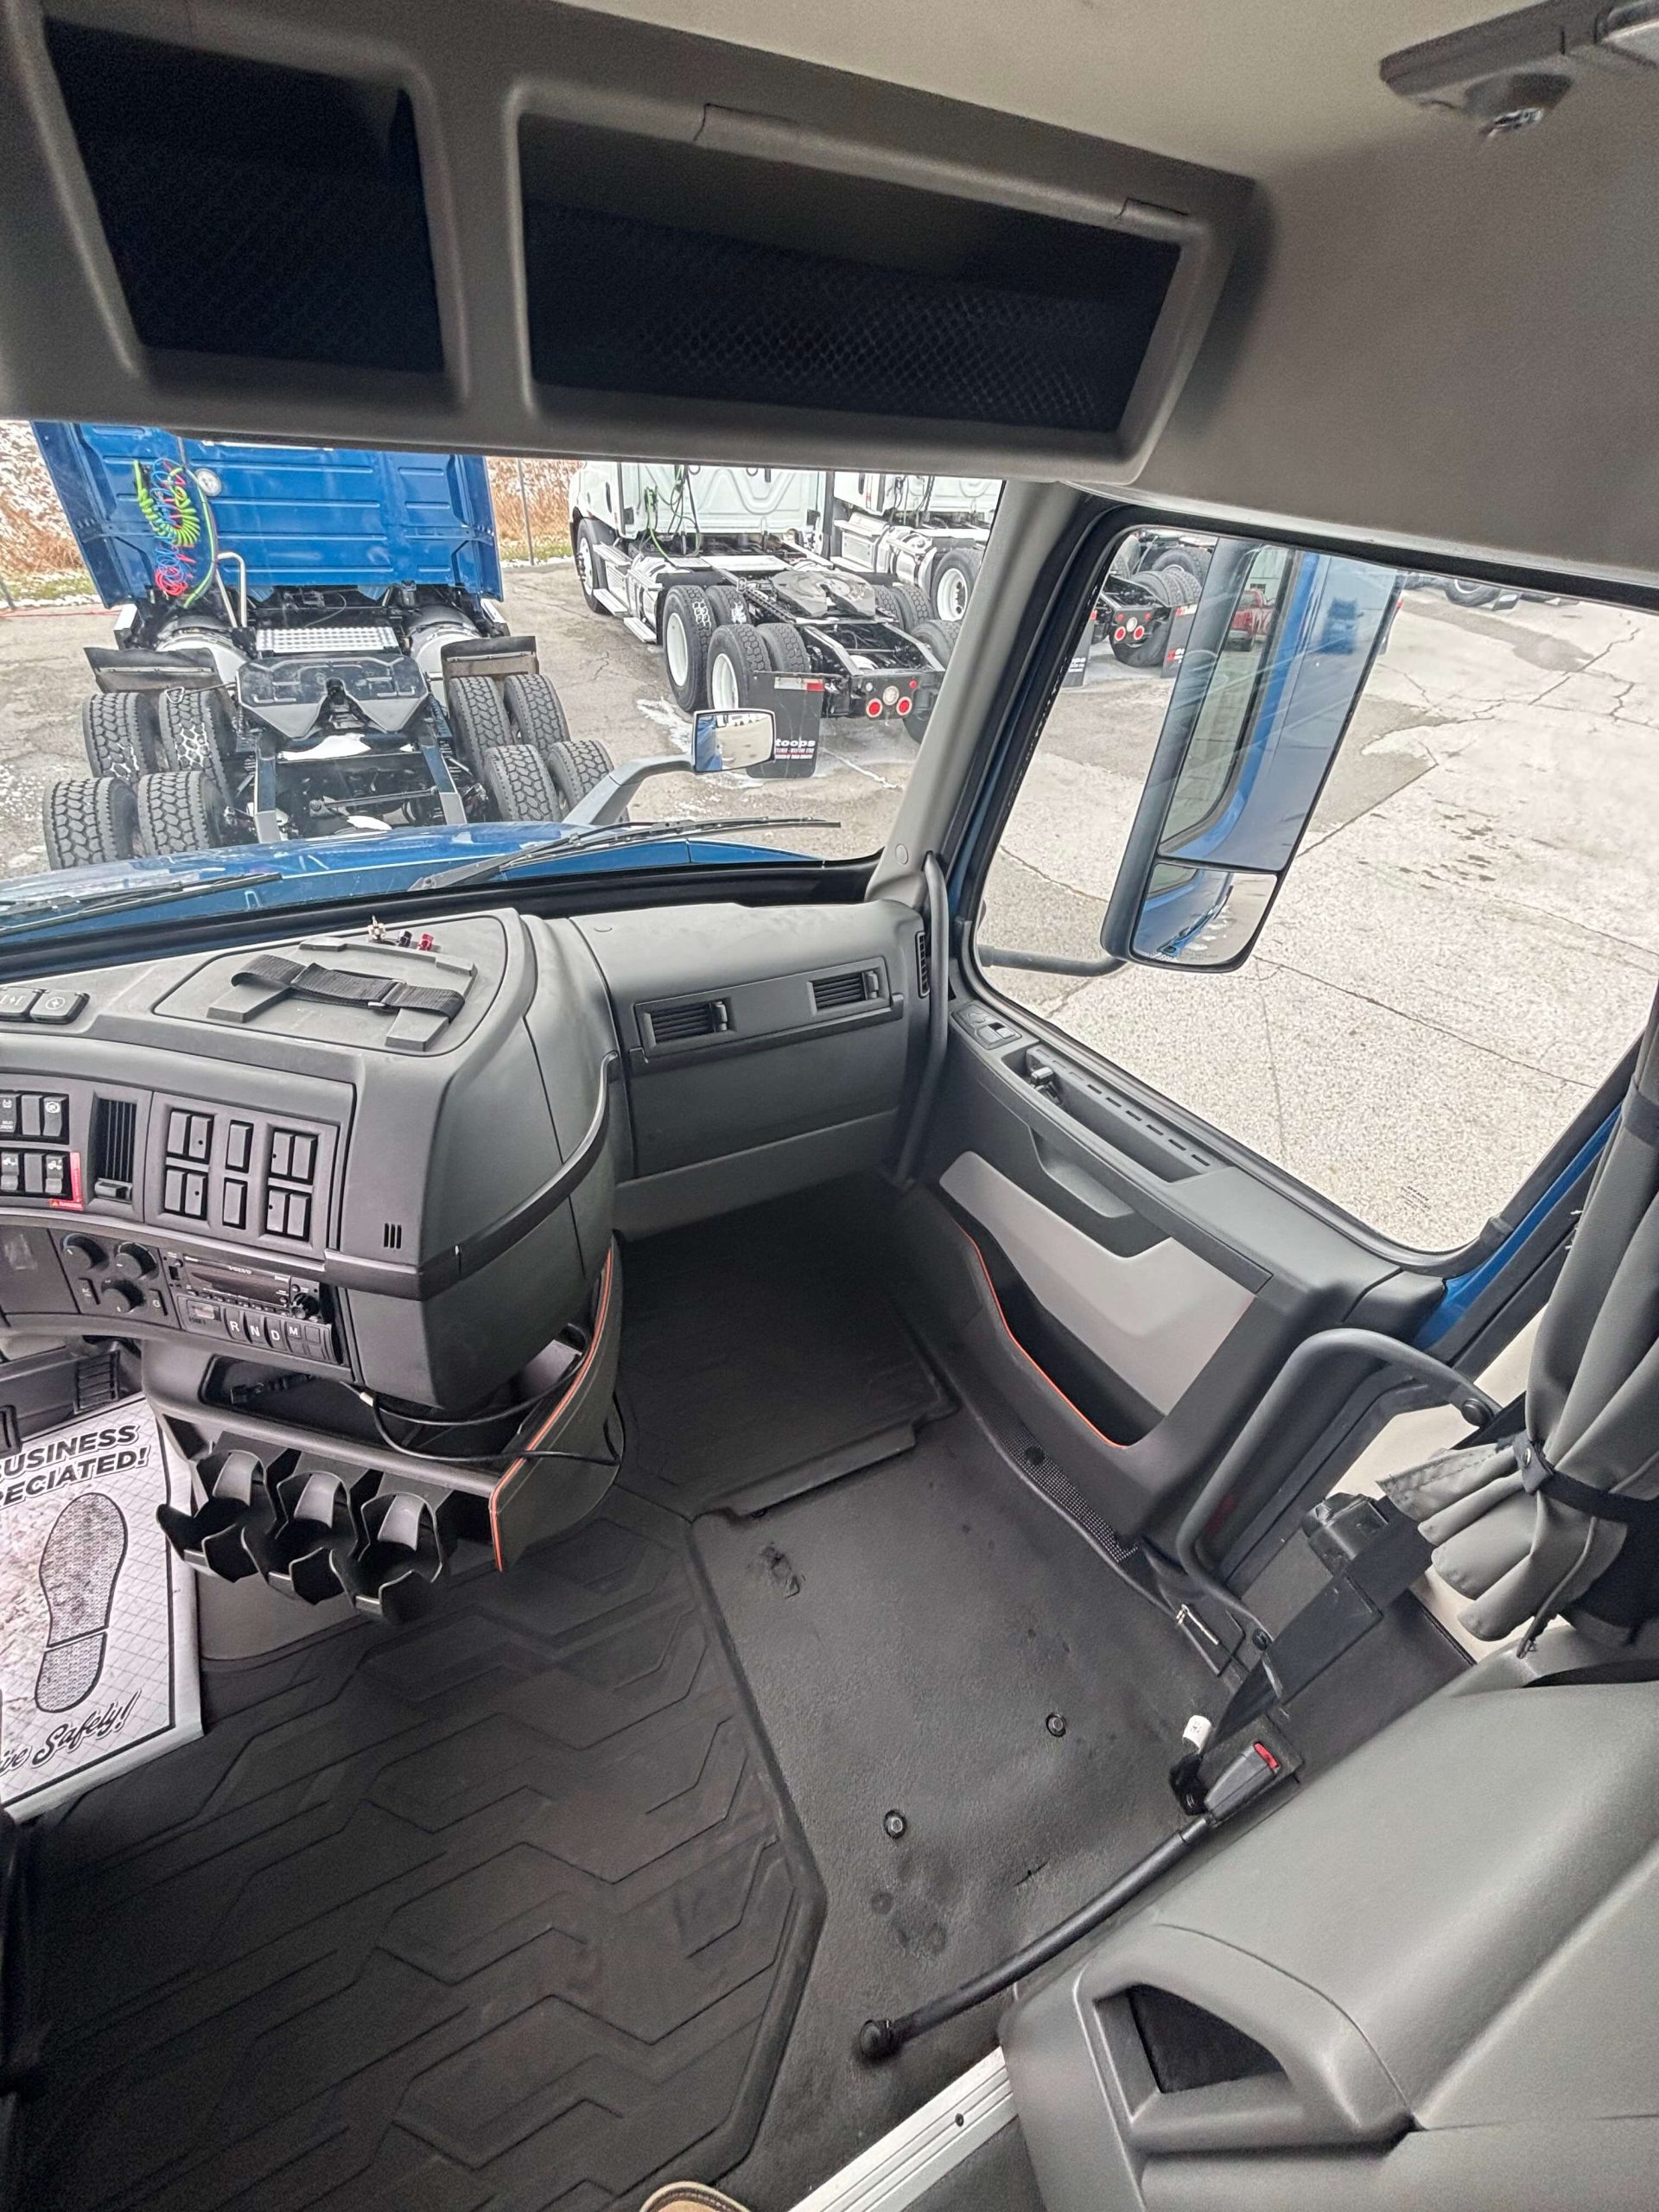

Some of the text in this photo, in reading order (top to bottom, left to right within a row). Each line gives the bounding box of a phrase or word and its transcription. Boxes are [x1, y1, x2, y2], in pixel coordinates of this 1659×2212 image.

[775, 738, 817, 748] toops
[228, 1266, 252, 1275] VOLVO
[229, 1320, 298, 1340] R N D M
[0, 1425, 141, 1478] USINESS
[0, 1446, 149, 1507] ECIATED!
[31, 1689, 142, 1765] Safely!
